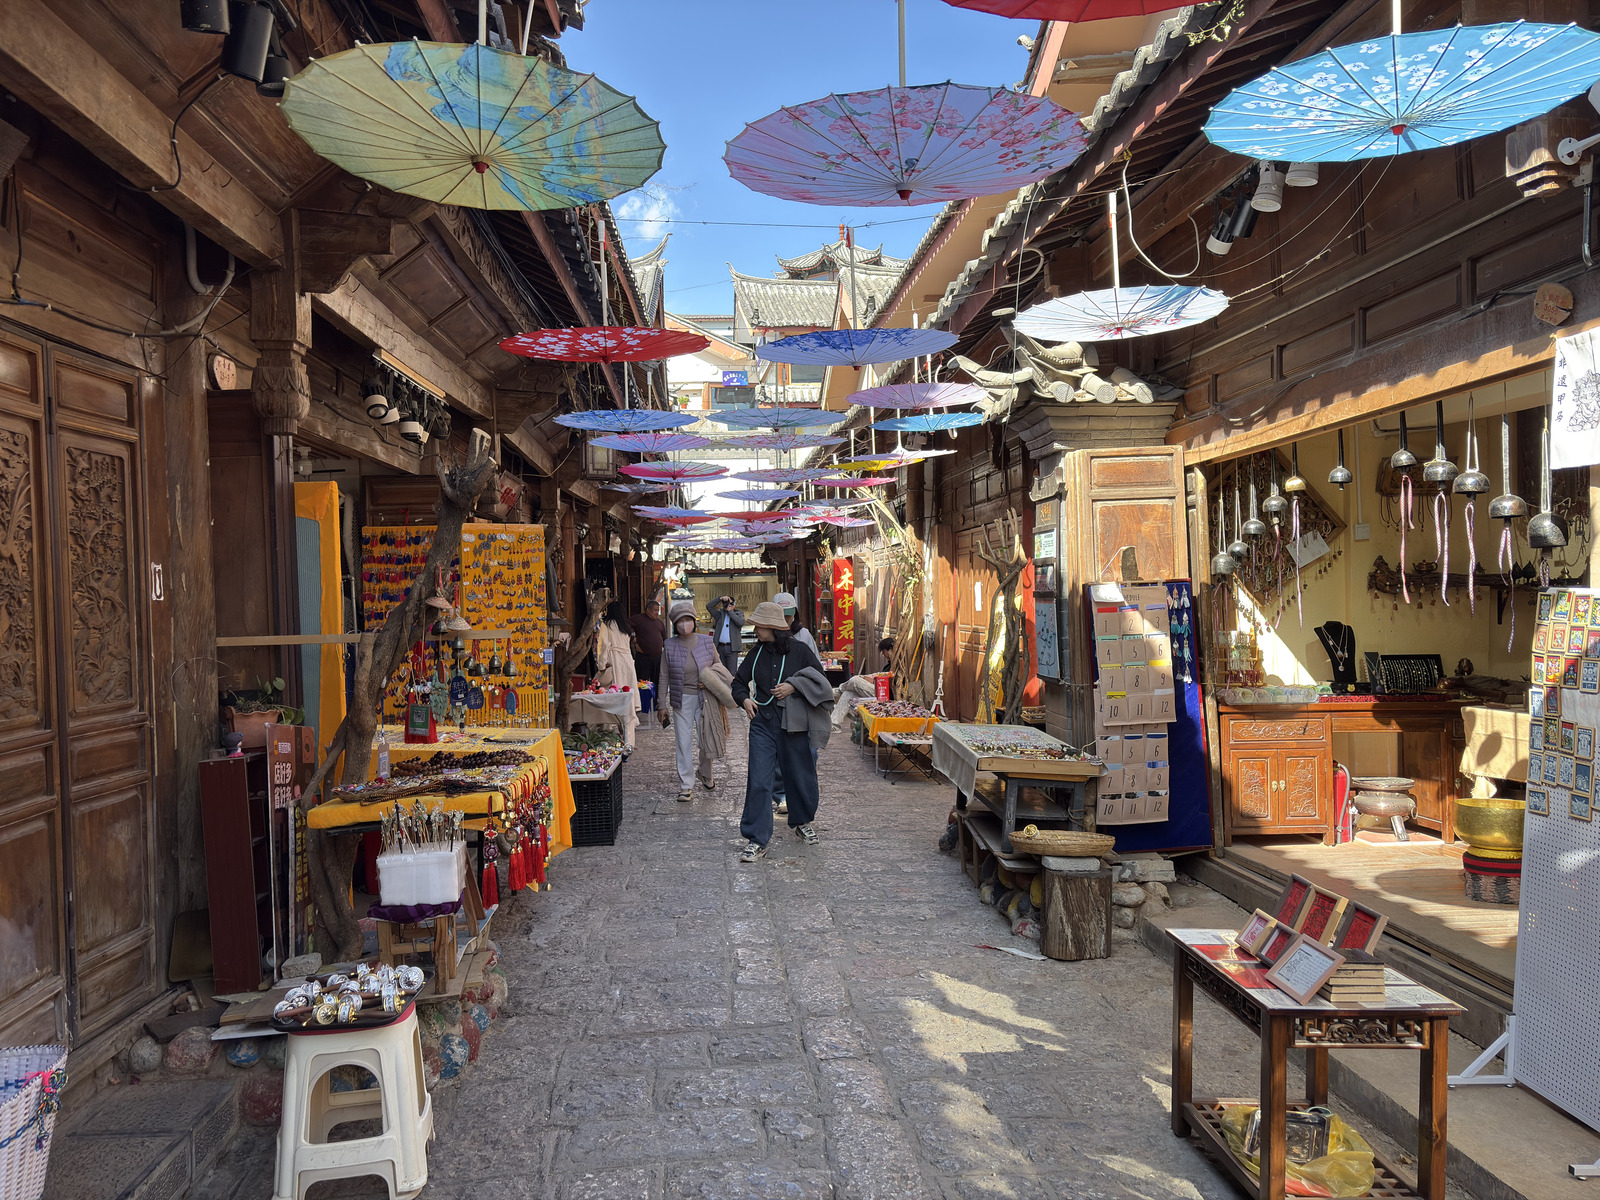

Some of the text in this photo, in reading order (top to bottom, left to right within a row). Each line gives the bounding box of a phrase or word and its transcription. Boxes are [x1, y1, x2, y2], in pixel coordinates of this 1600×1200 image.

[1555, 358, 1568, 423] 非遗甲马
[1104, 617, 1160, 633] 1 2 3
[1106, 644, 1163, 661] 4 5 6
[1109, 673, 1166, 689] 7 8 9
[1109, 706, 1119, 718] 10
[1136, 704, 1144, 716] 11
[1160, 702, 1169, 713] 12
[1104, 746, 1160, 760] 4 5 6
[1107, 774, 1162, 788] 7 8 9
[1103, 802, 1163, 815] 10 11 12
